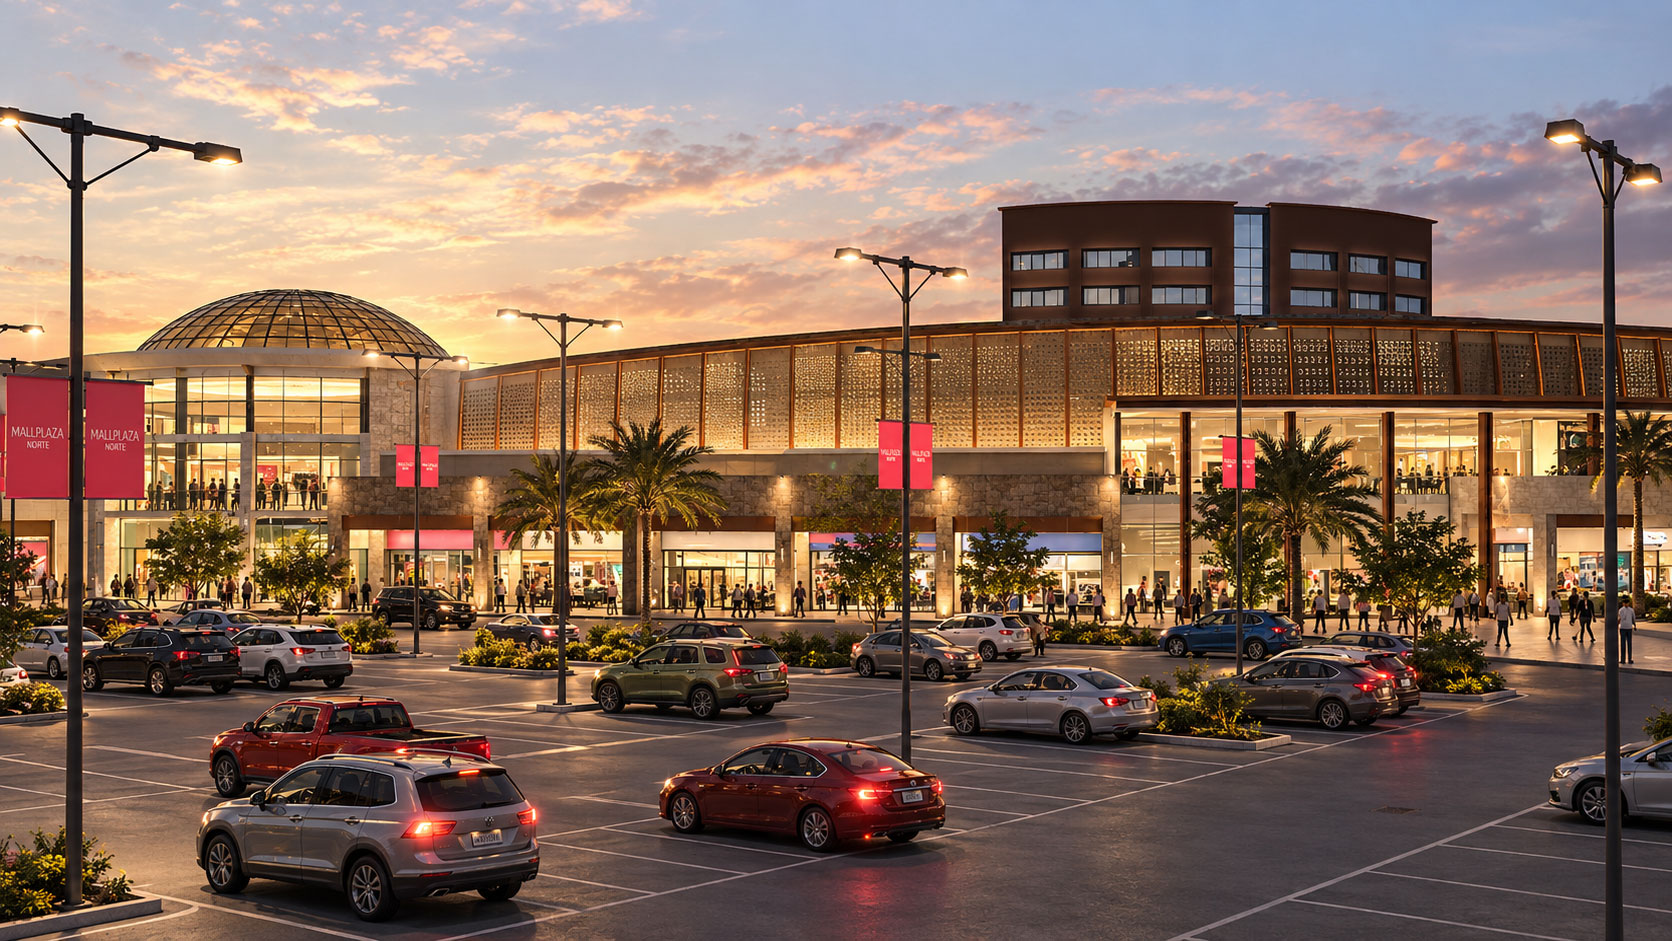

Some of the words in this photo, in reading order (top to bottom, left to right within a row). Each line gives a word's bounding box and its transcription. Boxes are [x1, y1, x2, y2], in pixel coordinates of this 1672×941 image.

[11, 426, 64, 439] MALLPLAZA
[90, 428, 140, 441] MALLPLAZA
[26, 440, 50, 449] NORTE
[104, 442, 127, 451] NORTE
